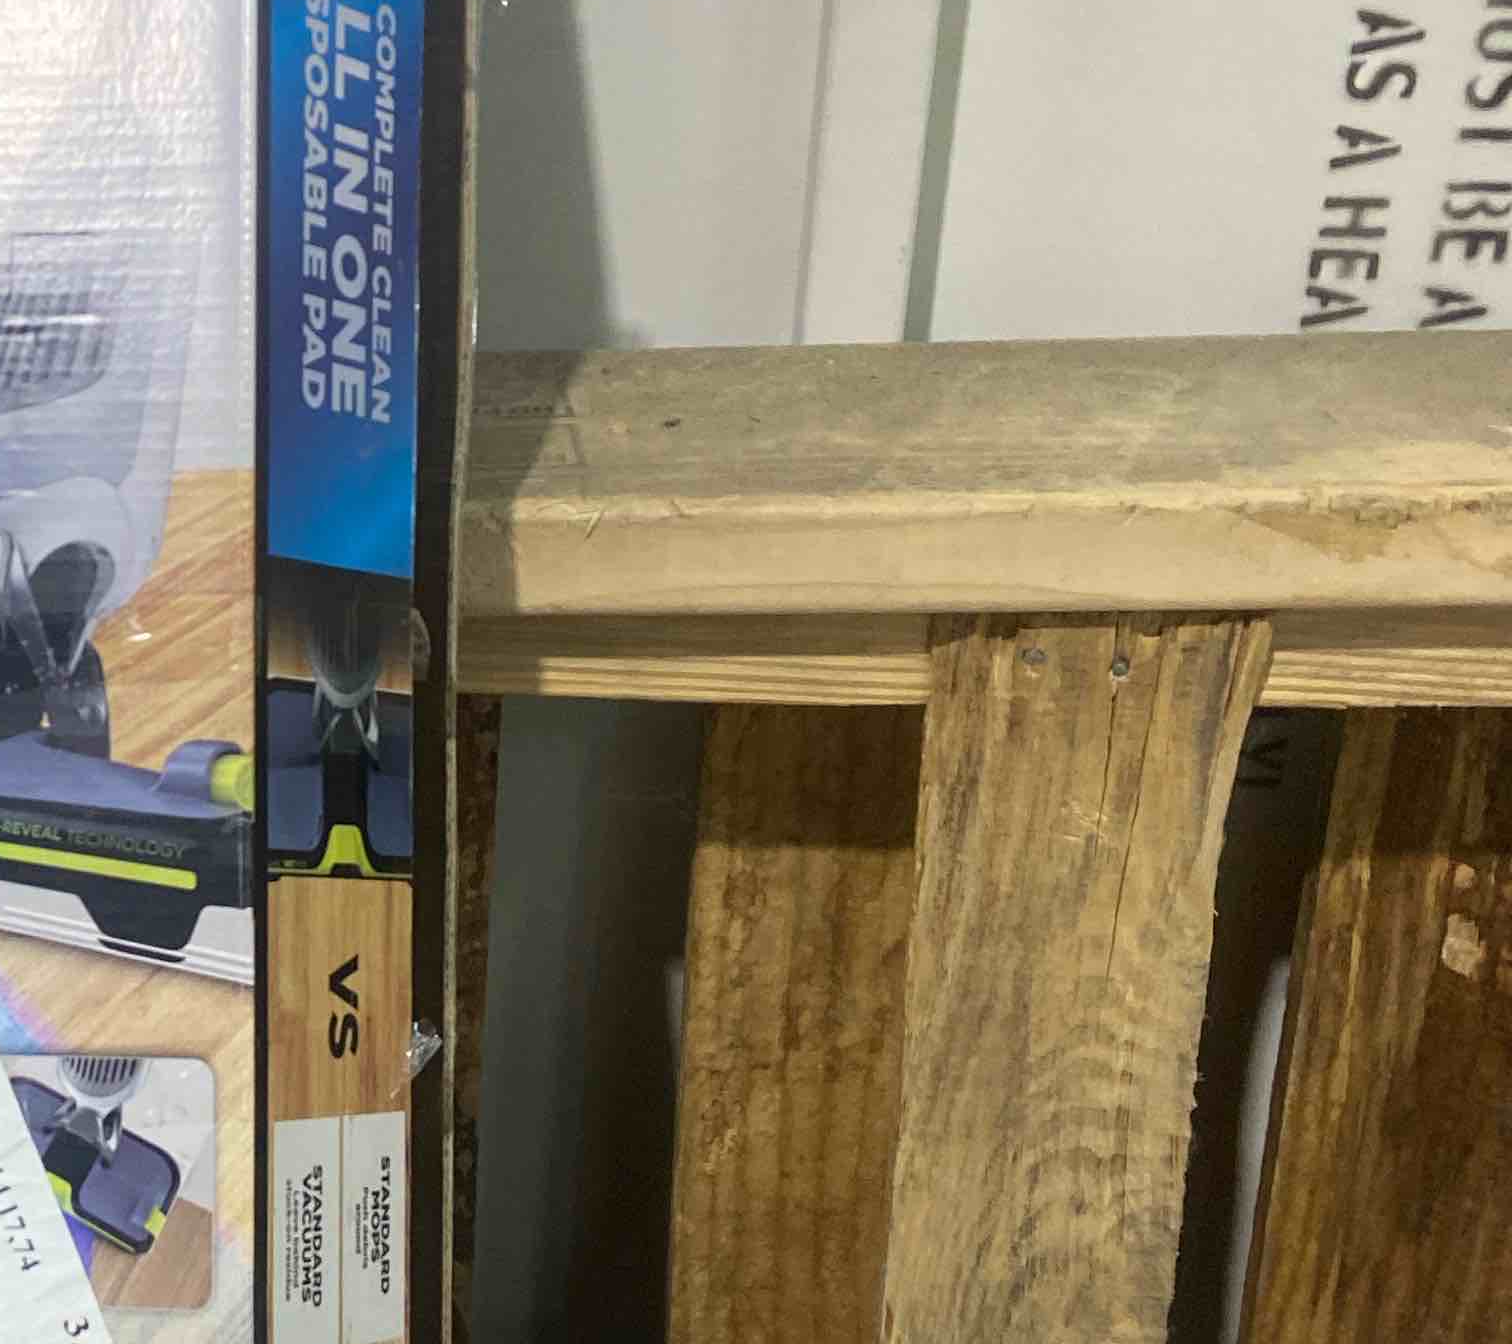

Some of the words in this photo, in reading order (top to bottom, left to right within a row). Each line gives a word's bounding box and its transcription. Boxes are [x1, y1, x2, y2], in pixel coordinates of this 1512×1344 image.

[1345, 9, 1427, 102] AS
[332, 127, 369, 214] IN
[372, 4, 397, 257] COMPLETE
[1327, 124, 1403, 170] A
[301, 290, 327, 411] PAD
[331, 234, 368, 420] ONE
[370, 263, 392, 424] CLEAN
[328, 954, 360, 1059] VS
[301, 1173, 312, 1304] VACUUMS
[311, 1164, 323, 1309] STANDARD
